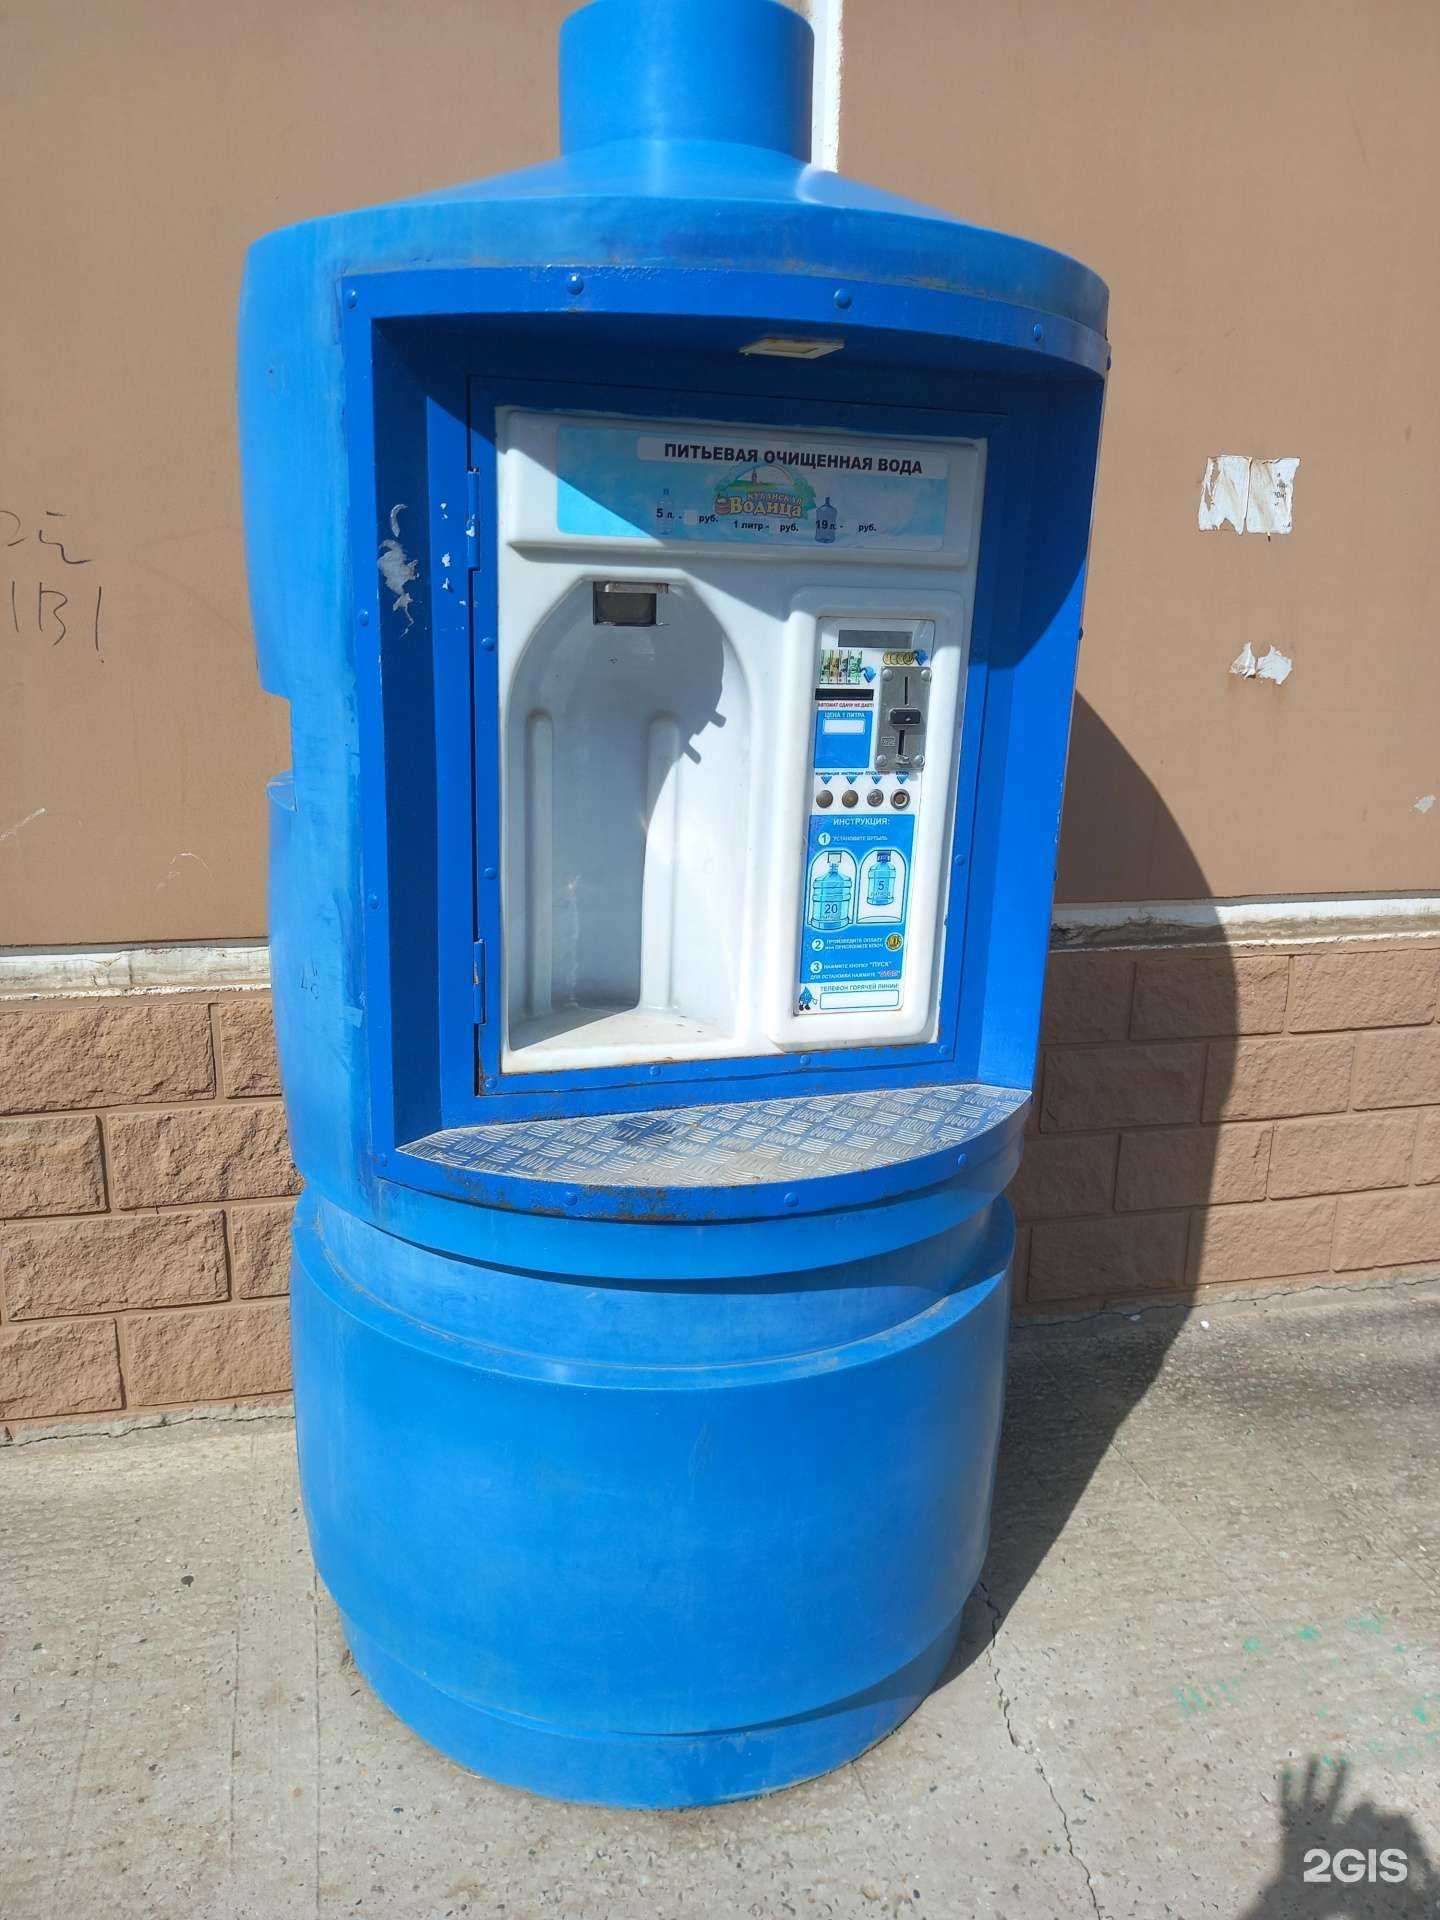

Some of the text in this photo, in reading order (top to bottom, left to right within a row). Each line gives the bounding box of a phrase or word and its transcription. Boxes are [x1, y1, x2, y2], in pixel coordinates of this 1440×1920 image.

[664, 443, 923, 476] ПИТЬЕВАЯ ОЧИЩЕННАЯ ВОДА
[730, 496, 802, 518] Водица
[656, 508, 664, 519] 5
[699, 513, 719, 525] руб.
[780, 523, 799, 533] руб.
[816, 520, 828, 530] 19
[858, 523, 877, 533] руб.
[833, 817, 890, 826] ИНСТРУКЦИЯ:
[878, 880, 885, 891] 5
[824, 903, 838, 914] 20
[849, 983, 877, 991] ГОРЯЧЕЙ
